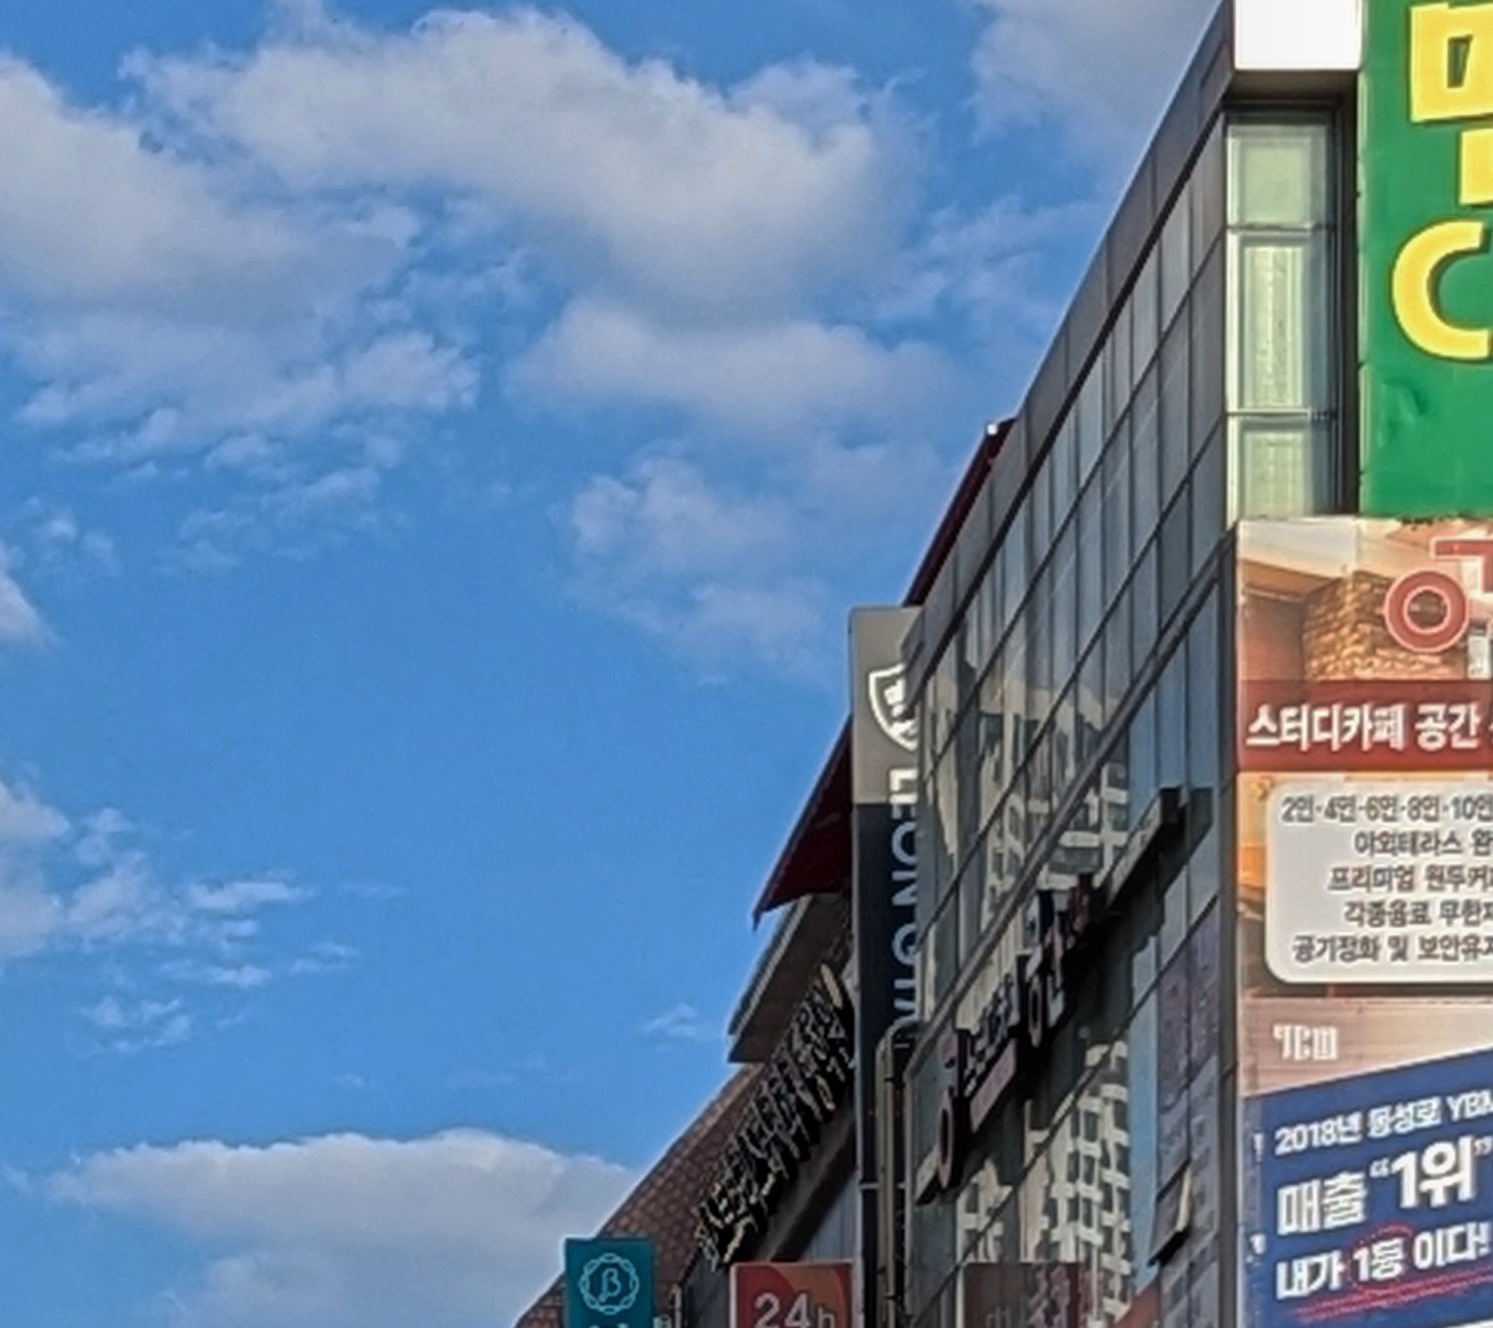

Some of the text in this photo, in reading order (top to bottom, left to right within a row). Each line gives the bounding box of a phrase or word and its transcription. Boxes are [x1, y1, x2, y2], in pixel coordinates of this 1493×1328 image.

[1246, 704, 1479, 751] 스터디카페 공간
[1328, 866, 1493, 892] 프리미엄 원두커
[1344, 901, 1431, 927] 각종음료
[1294, 936, 1379, 963] 공기정화
[1275, 1112, 1362, 1155] 2018년
[1367, 1097, 1441, 1136] 동성로
[1277, 1170, 1367, 1236] 매출
[1276, 1221, 1490, 1300] 내가 1등 이다!
